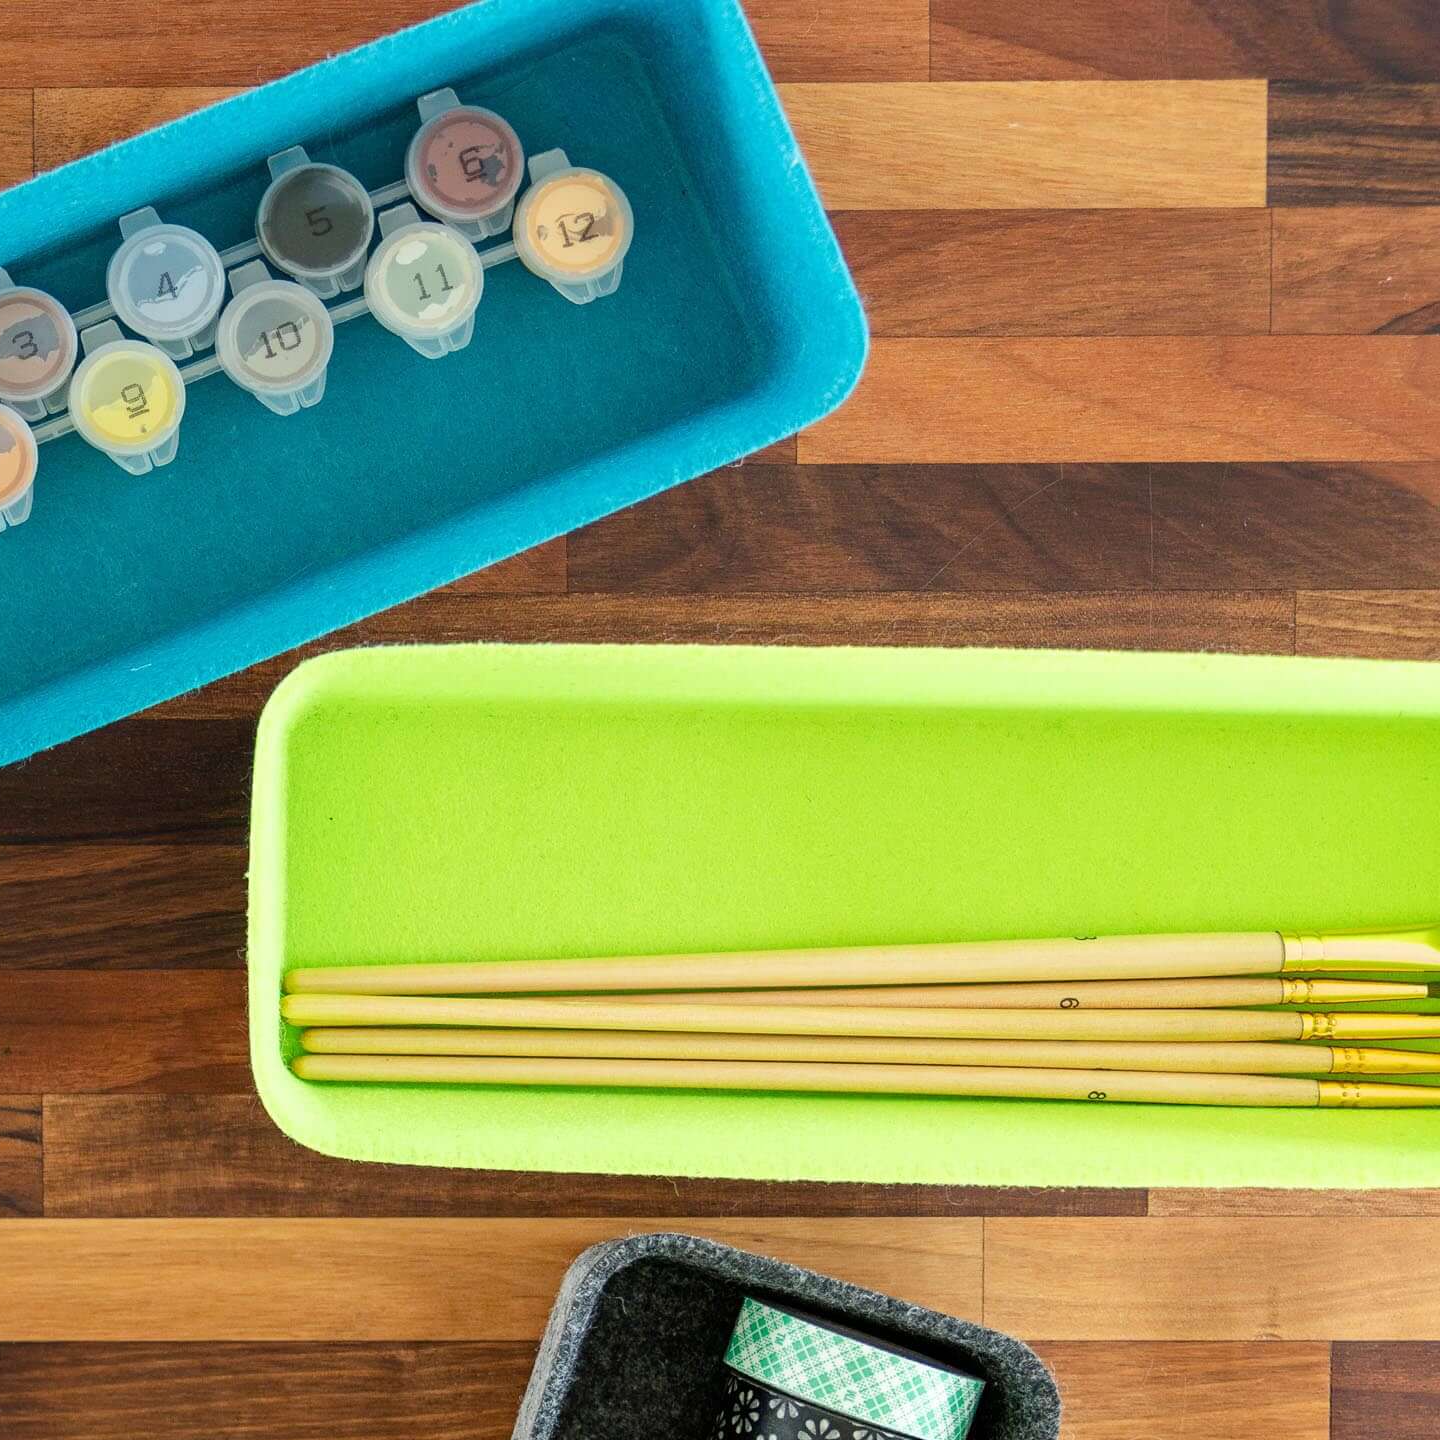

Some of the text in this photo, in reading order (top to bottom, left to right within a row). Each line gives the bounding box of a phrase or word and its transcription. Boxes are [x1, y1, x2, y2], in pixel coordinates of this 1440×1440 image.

[459, 145, 487, 183] 6
[304, 205, 334, 237] 5
[557, 211, 600, 249] 12
[157, 271, 178, 299] 4
[409, 263, 454, 301] 11
[12, 330, 38, 360] 3
[258, 320, 303, 360] 10
[120, 383, 150, 418] 9
[1087, 1090, 1107, 1101] 8
